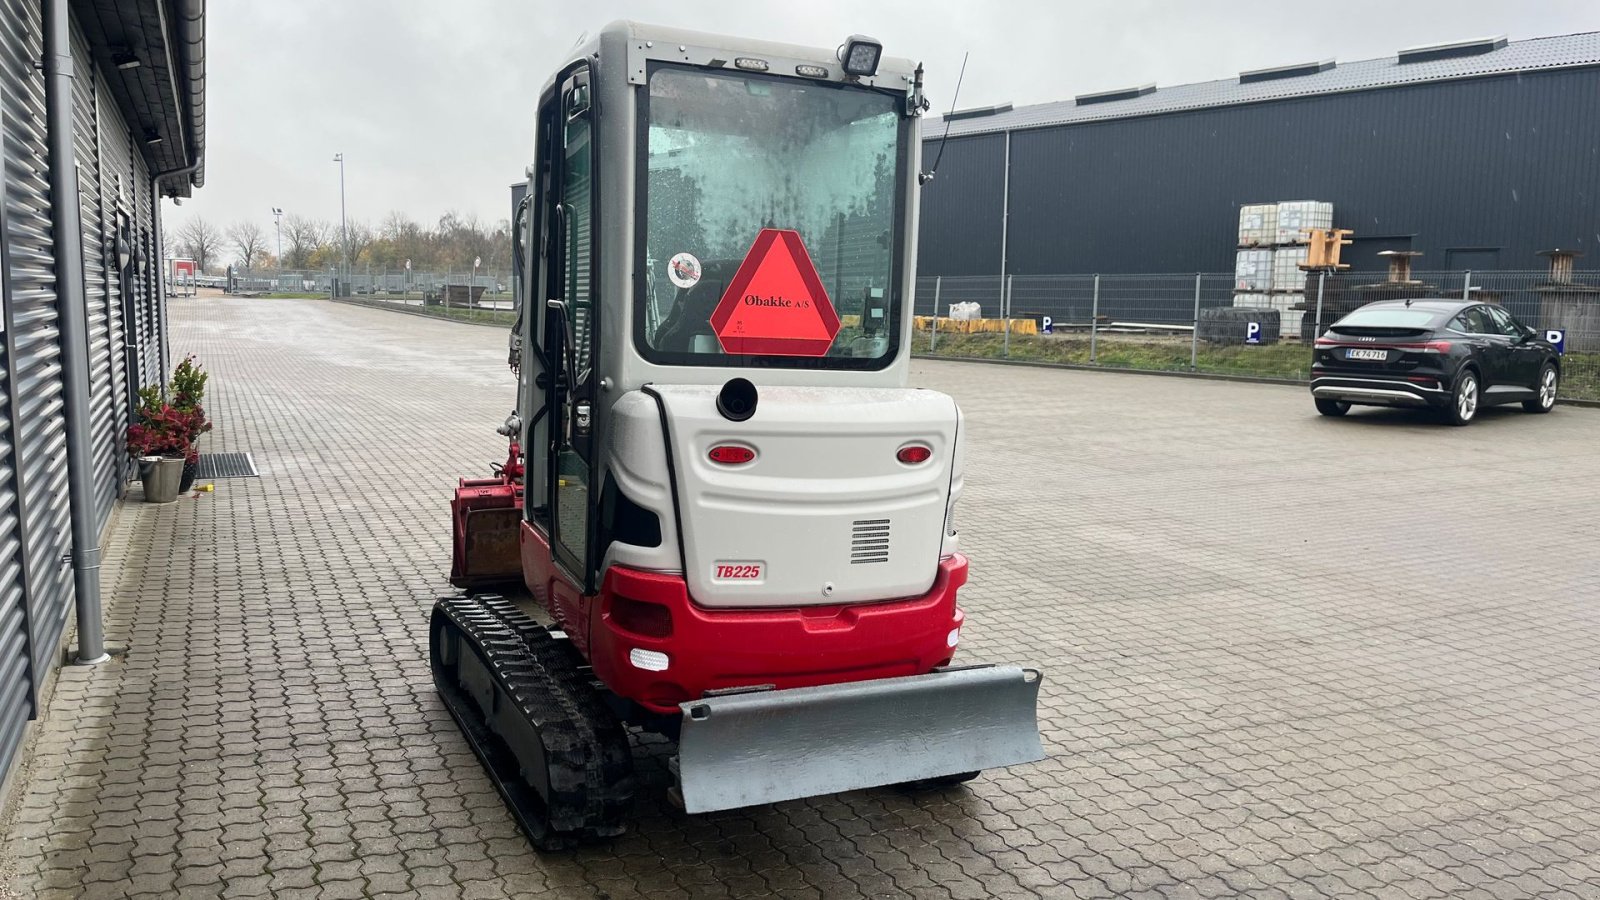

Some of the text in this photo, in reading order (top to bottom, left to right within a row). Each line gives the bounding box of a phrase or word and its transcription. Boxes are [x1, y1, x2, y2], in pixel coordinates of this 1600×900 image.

[744, 294, 810, 309] Øbakke A/S
[1043, 316, 1052, 330] P
[1247, 322, 1260, 339] P
[717, 565, 760, 578] TB225
